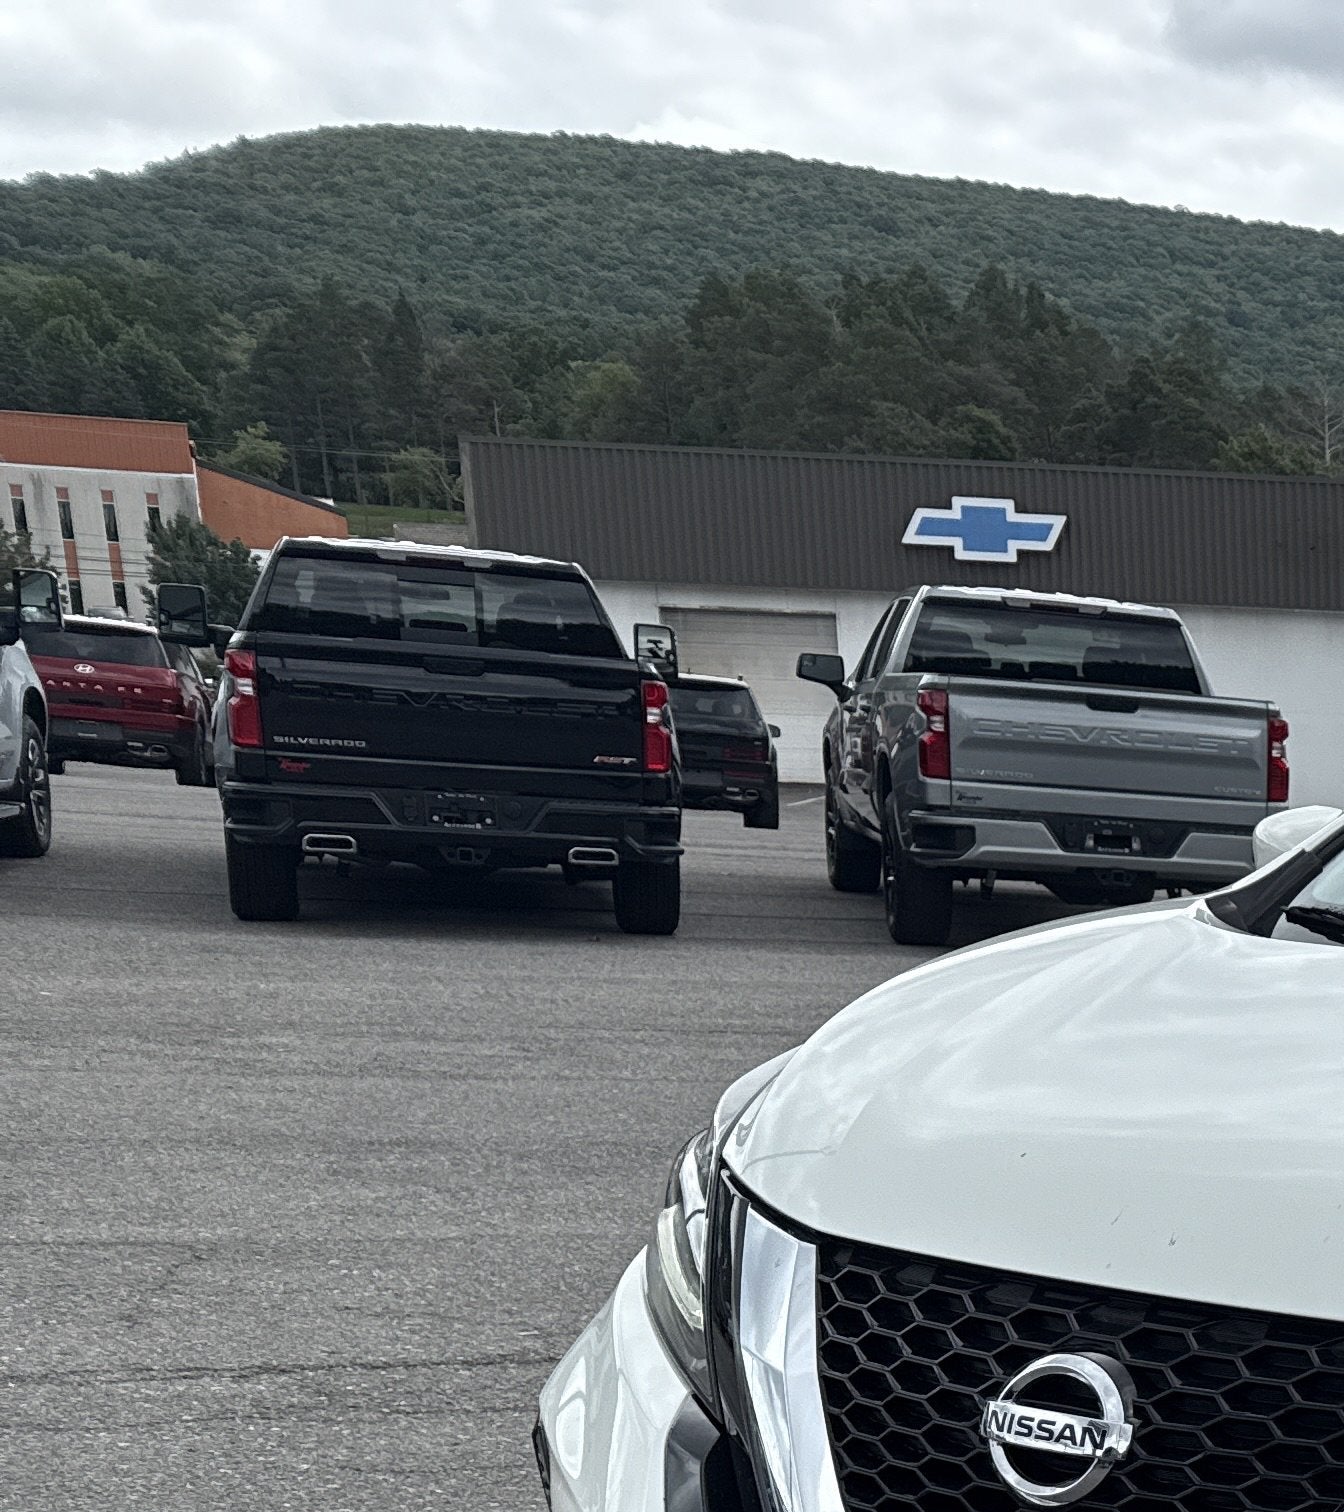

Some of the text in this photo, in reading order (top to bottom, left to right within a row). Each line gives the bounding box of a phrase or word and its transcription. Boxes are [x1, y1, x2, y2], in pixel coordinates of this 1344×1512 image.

[46, 679, 104, 692] ANTA
[272, 735, 367, 748] SILVERADO
[972, 717, 1251, 754] CHEVROLET
[988, 1409, 1108, 1451] NISSAN
